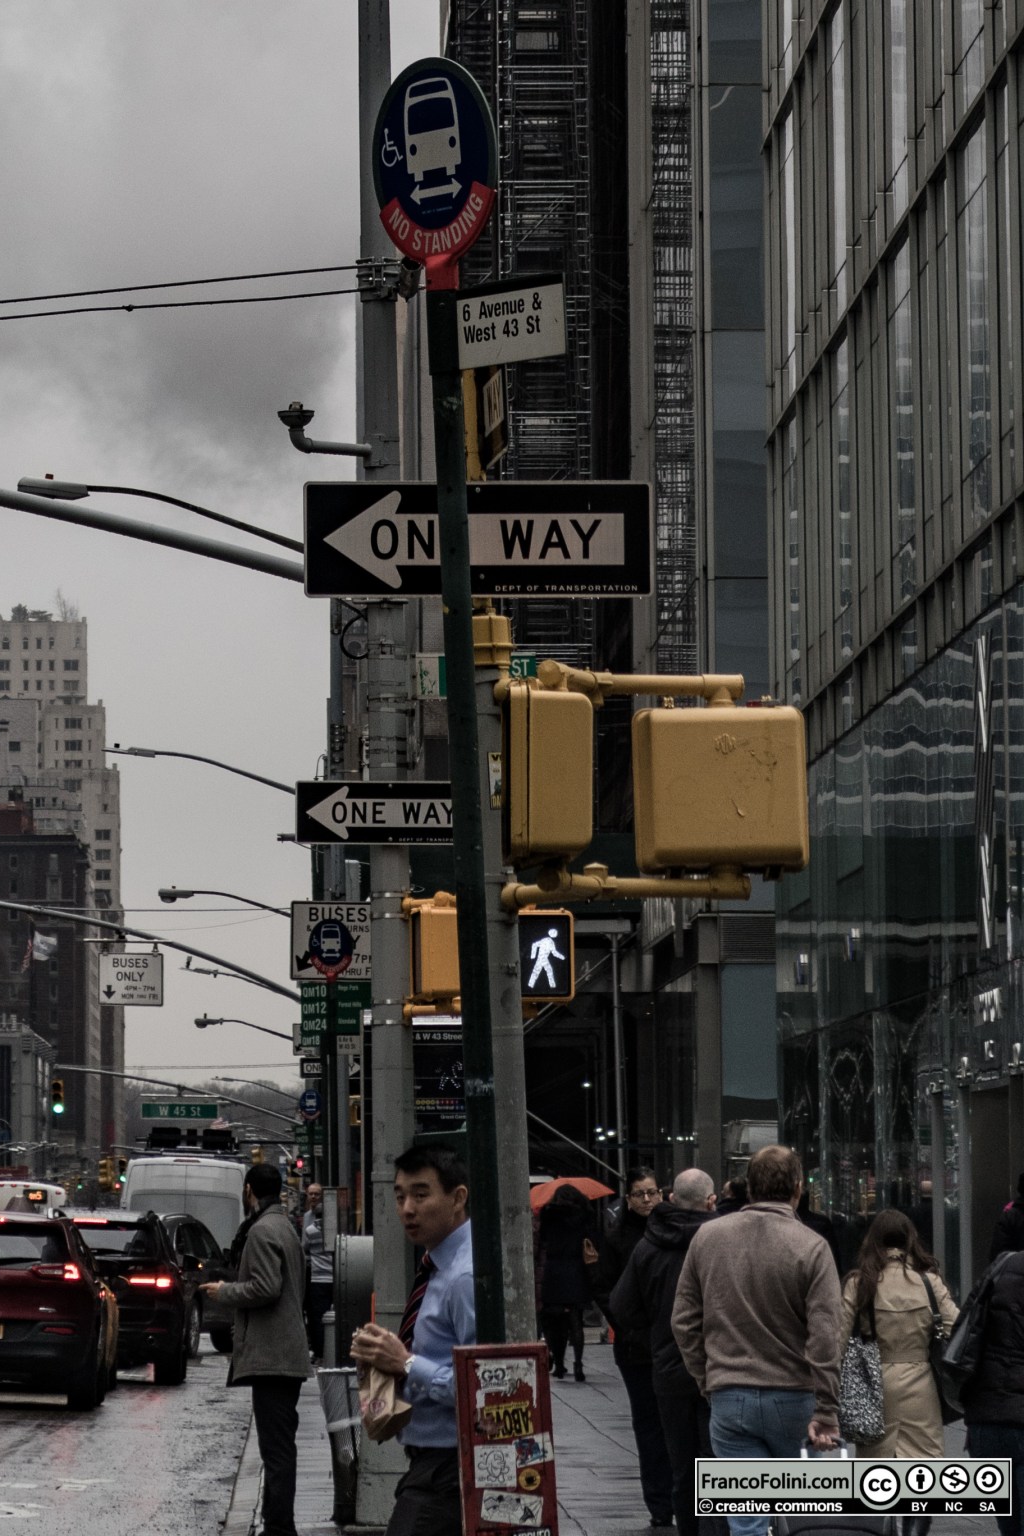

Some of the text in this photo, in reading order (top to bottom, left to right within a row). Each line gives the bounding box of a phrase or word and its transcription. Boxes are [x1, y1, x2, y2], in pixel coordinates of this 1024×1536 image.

[388, 192, 484, 254] NO STANDING
[462, 292, 542, 322] 6 Avenue &
[463, 314, 541, 344] West 43 St
[370, 519, 602, 560] ON WAY
[494, 584, 638, 592] DEPT OF TRANSPORTATION
[511, 658, 530, 677] ST
[332, 801, 453, 824] ONE WAY
[309, 907, 367, 922] BUSES
[112, 957, 149, 969] BUSES
[116, 971, 145, 982] ONLY
[302, 985, 327, 998] QM10
[302, 1001, 327, 1014] QM12
[302, 1018, 327, 1031] QM24
[422, 1032, 430, 1041] W
[431, 1032, 441, 1041] 43
[442, 1032, 463, 1041] Stree
[159, 1105, 201, 1117] W 45 St
